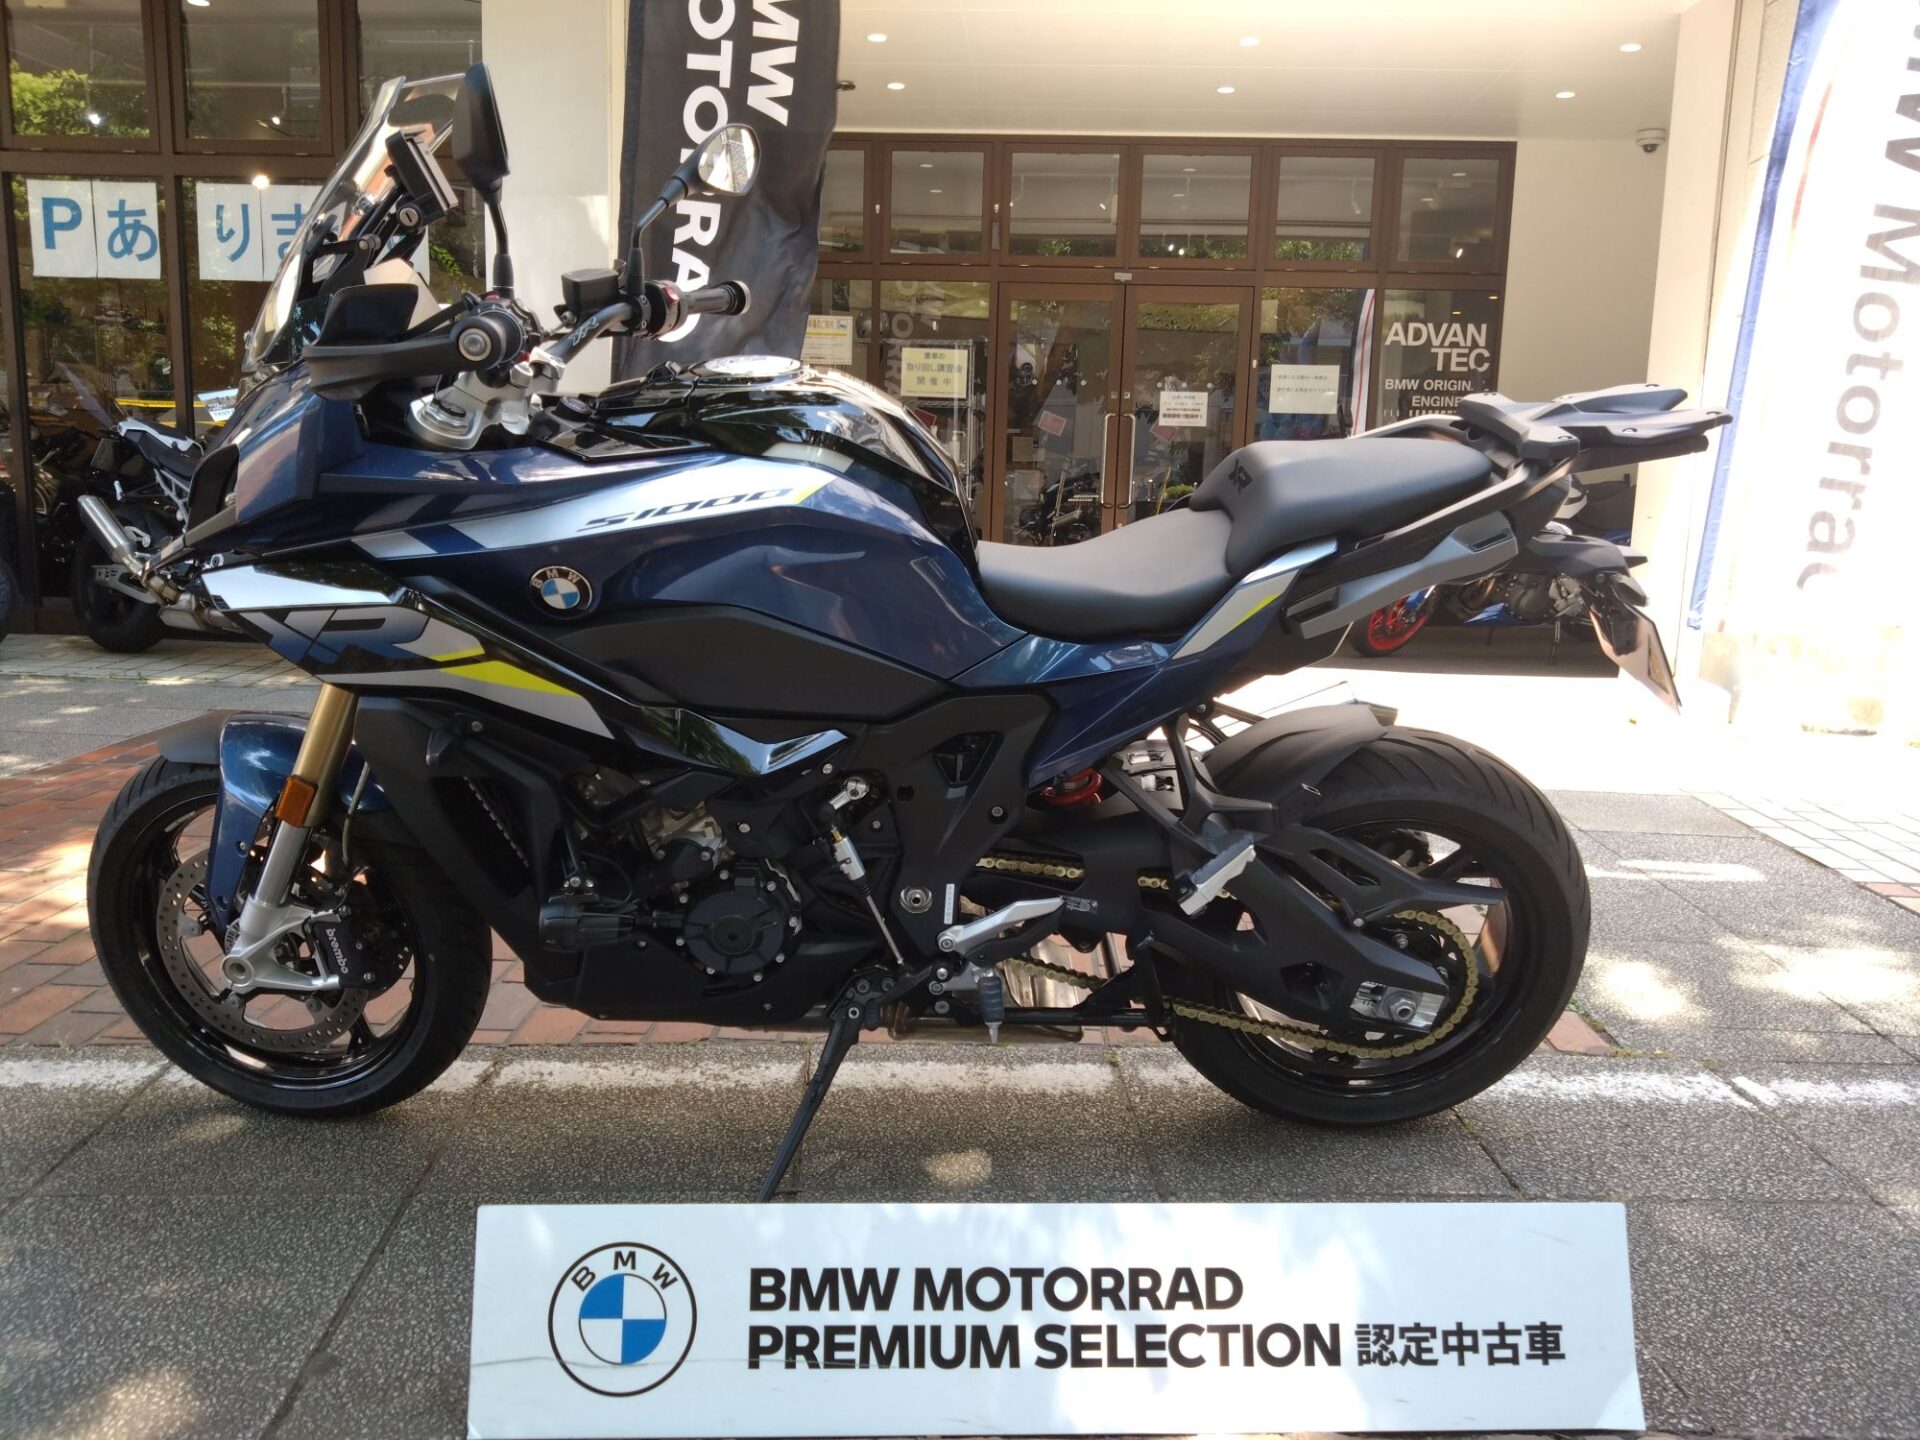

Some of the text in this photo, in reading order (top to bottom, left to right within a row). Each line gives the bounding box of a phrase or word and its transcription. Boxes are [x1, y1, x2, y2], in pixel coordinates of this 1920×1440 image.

[657, 0, 736, 342] OTORA
[41, 196, 406, 262] Pありま
[1384, 322, 1488, 347] ADVAN
[1431, 347, 1491, 372] TEC
[1384, 379, 1475, 391] BMW ORIGIN
[576, 488, 793, 533] S1000
[531, 568, 581, 589] BMW
[325, 928, 349, 974] brembo
[571, 1250, 678, 1292] BMW
[749, 1266, 1243, 1312] BMW MOTORRAD
[748, 1321, 1567, 1369] PREMIUM SELECTION 認定中古車
